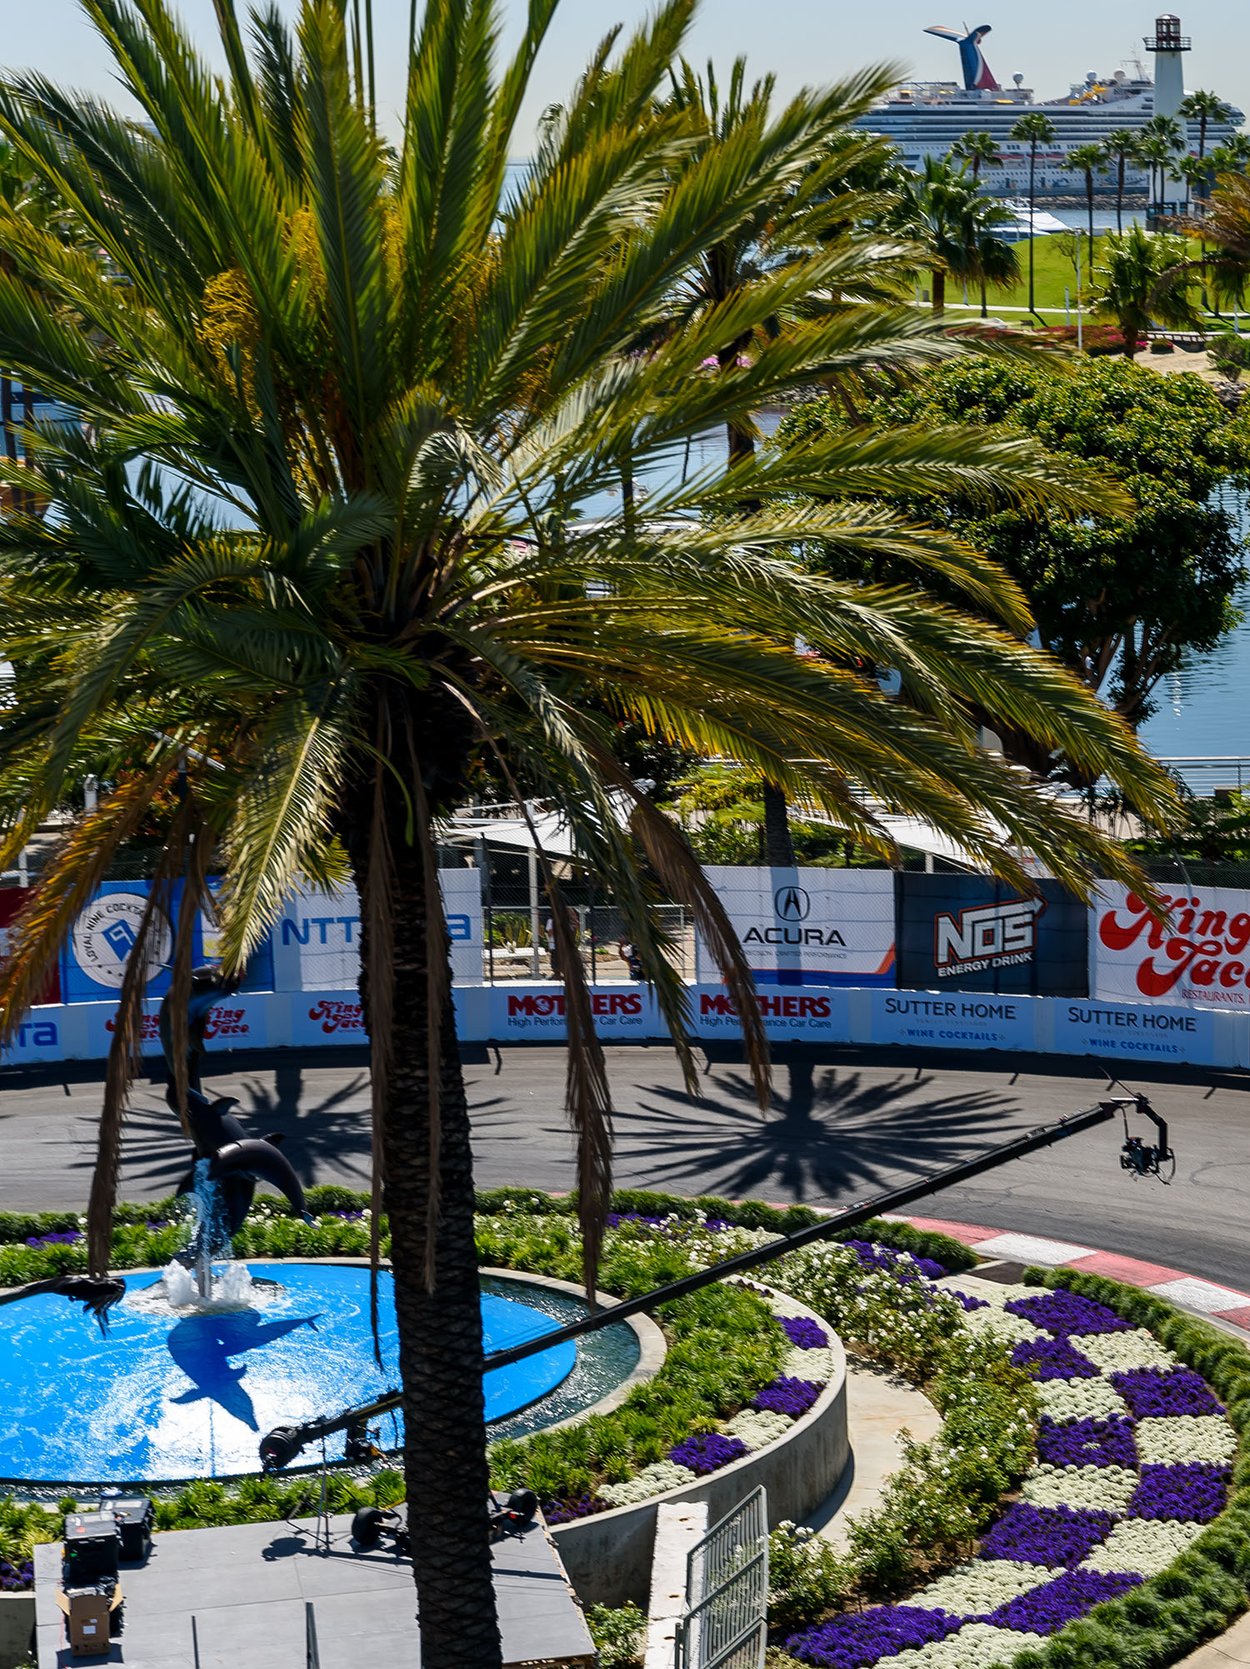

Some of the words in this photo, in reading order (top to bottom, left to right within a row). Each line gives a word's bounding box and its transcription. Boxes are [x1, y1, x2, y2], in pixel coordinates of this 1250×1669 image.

[88, 909, 106, 932] NINE
[281, 916, 360, 946] NTT
[935, 897, 1048, 967] NOS
[84, 933, 100, 963] LOYAL
[743, 926, 847, 947] ACURA
[938, 959, 991, 978] ENERGY
[991, 951, 1033, 968] DRINK
[507, 993, 642, 1017] MOTERS
[701, 994, 832, 1018] MOHERS
[885, 998, 957, 1016] SUTTER
[961, 1002, 1016, 1020] HOME
[507, 1017, 532, 1028] High
[599, 1016, 618, 1027] Car
[619, 1016, 643, 1027] Care
[788, 1018, 807, 1029] Car
[808, 1018, 832, 1029] Care
[1068, 1006, 1138, 1028] SUTTER
[1143, 1014, 1197, 1032] HOME
[907, 1028, 934, 1039] WINE
[938, 1029, 998, 1042] COCKTAILS
[1089, 1037, 1117, 1049] WINE
[1120, 1040, 1179, 1054] COCKTAILS
